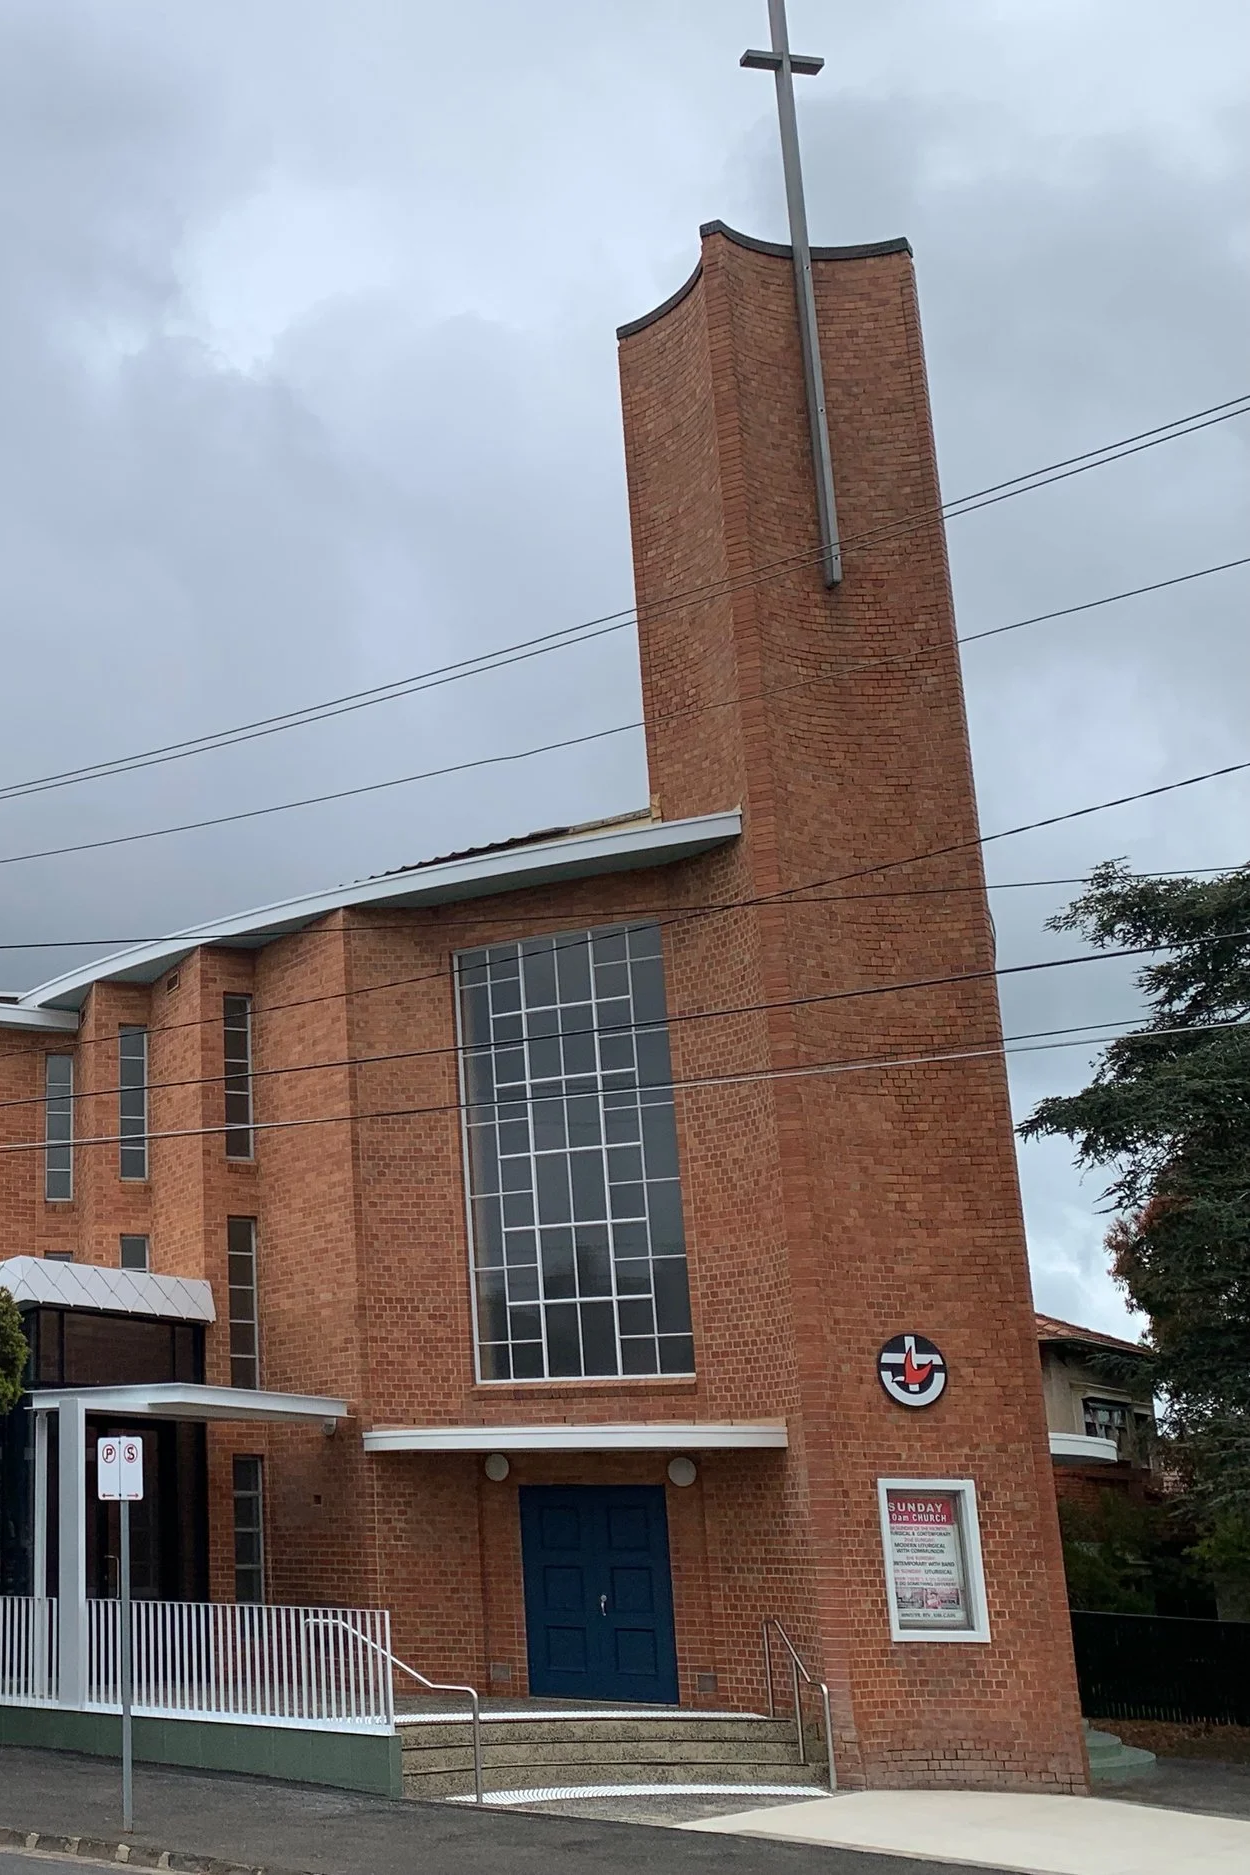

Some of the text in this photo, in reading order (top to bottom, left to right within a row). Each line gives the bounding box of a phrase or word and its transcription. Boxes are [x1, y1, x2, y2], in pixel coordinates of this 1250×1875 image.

[888, 1502, 943, 1513] SUNDAY
[890, 1513, 947, 1522] 0am CHURCH
